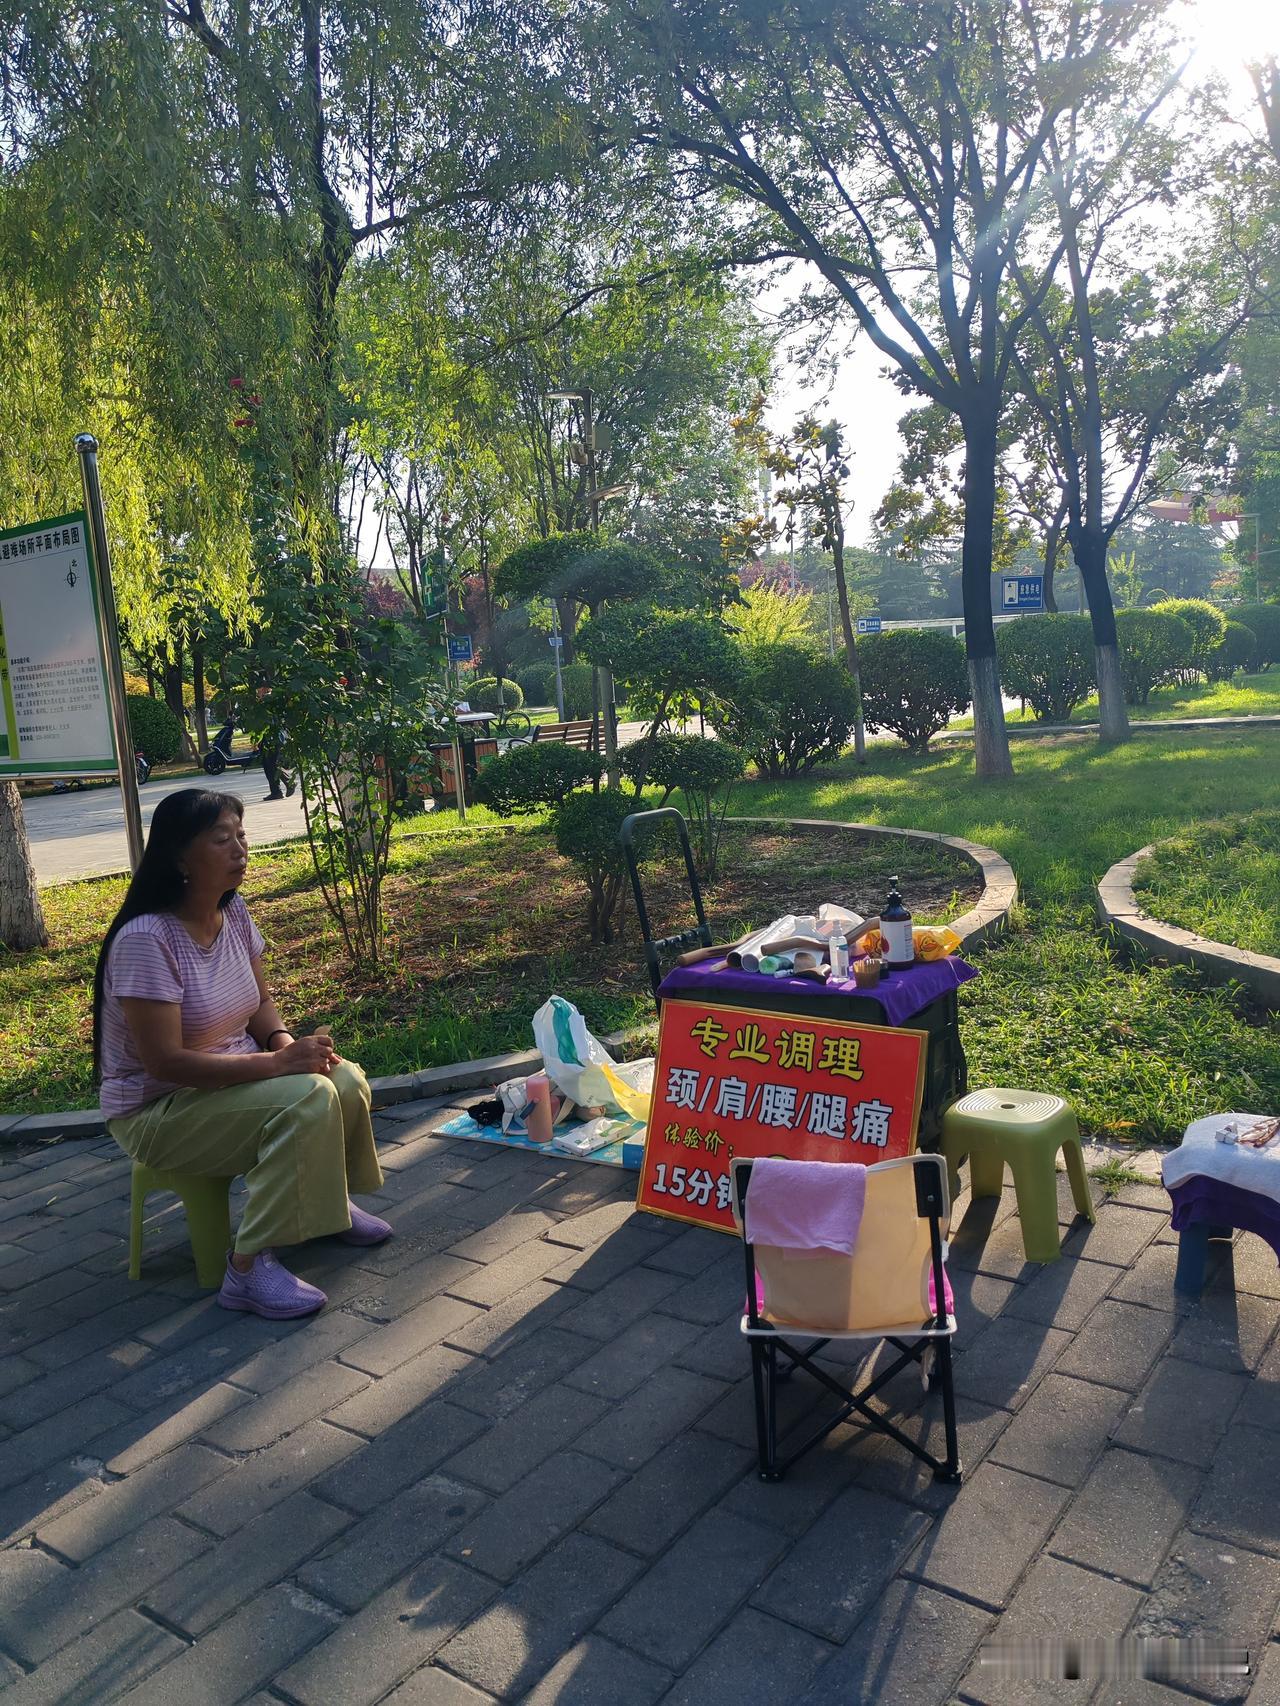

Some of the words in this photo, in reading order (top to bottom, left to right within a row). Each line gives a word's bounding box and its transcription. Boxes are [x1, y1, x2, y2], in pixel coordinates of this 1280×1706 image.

[0, 527, 80, 560] 避难场所平面布局图
[690, 1016, 864, 1081] 专业调理
[664, 1067, 893, 1147] 颈/肩/腰/腿痛
